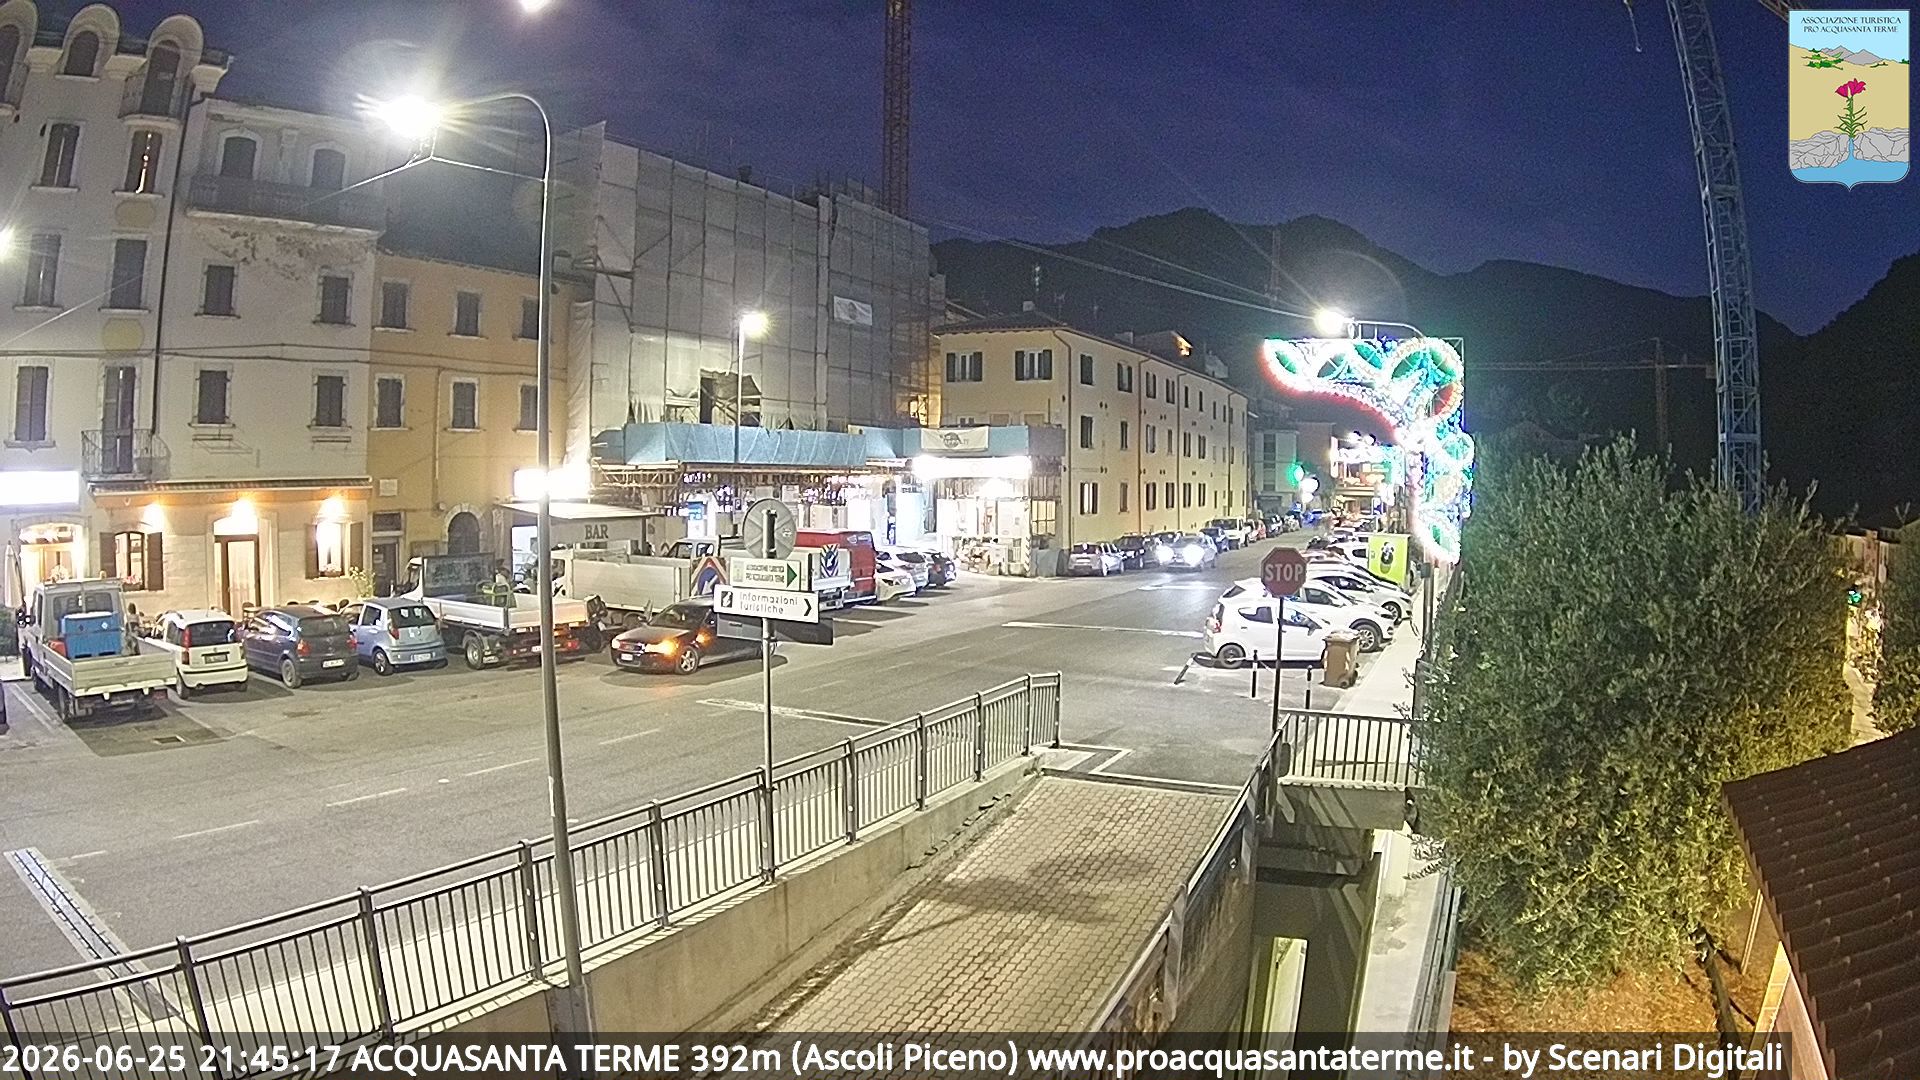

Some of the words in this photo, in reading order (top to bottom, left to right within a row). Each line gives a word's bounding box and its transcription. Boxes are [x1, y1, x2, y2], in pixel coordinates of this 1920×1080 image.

[585, 524, 609, 540] BAR
[1265, 563, 1303, 582] STOP
[740, 591, 798, 606] Informazioni
